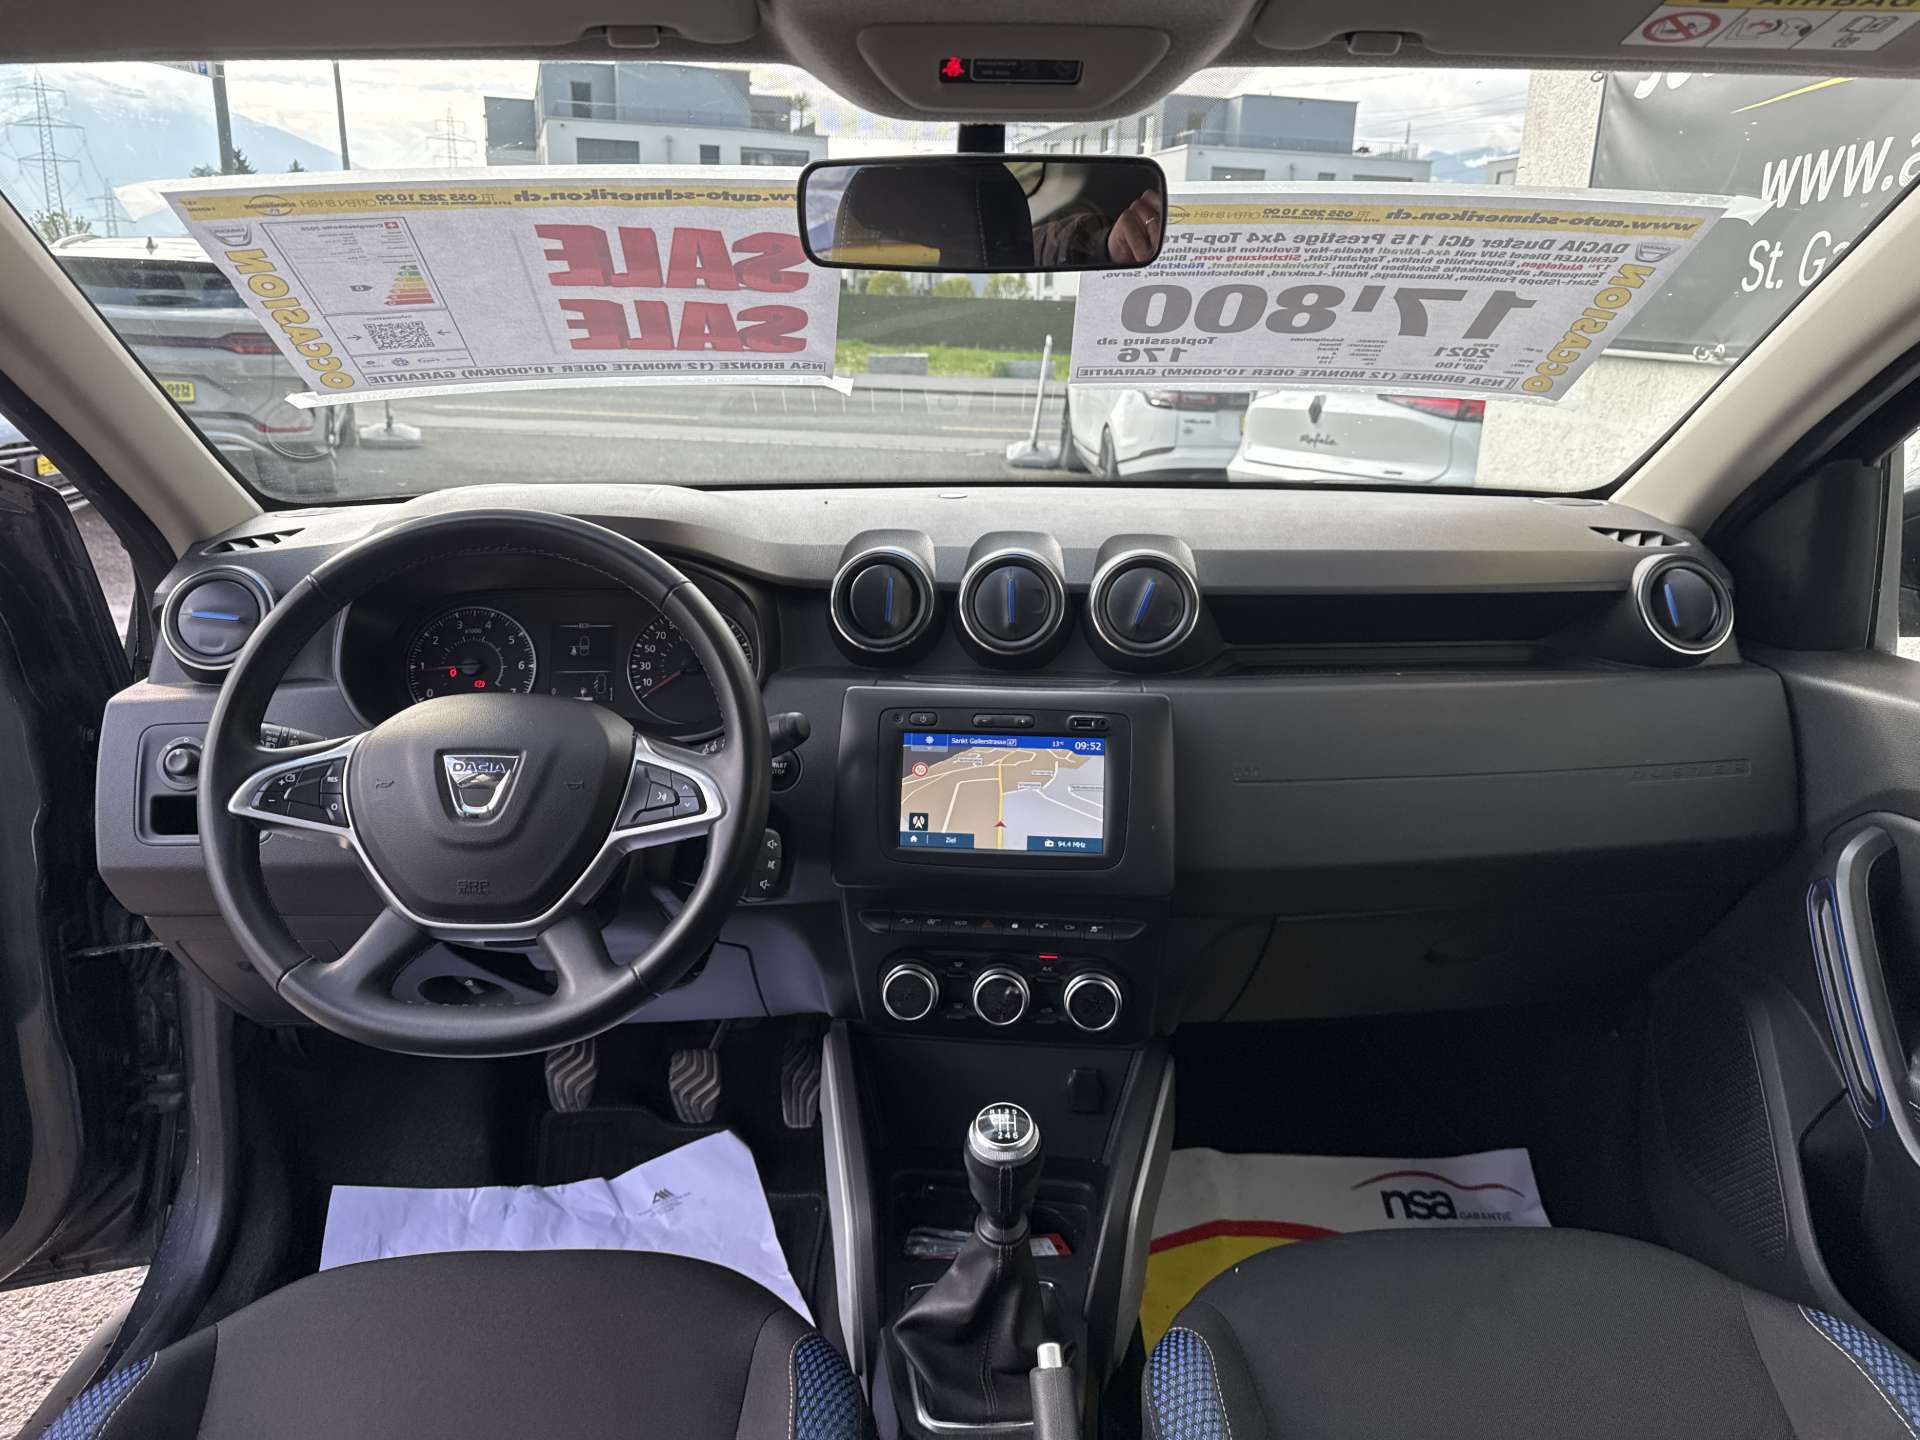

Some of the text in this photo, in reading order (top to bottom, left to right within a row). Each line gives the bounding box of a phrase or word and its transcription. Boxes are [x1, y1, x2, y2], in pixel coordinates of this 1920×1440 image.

[1741, 230, 1851, 292] St. G
[456, 621, 463, 629] 3
[485, 621, 492, 629] 4
[509, 635, 515, 644] 5
[655, 631, 666, 640] 70
[433, 636, 439, 645] 2
[644, 644, 656, 653] 50
[518, 661, 525, 670] 6
[639, 661, 651, 670] 30
[642, 678, 652, 687] 10
[426, 688, 433, 697] 0
[1074, 741, 1102, 751] 09:52
[452, 761, 506, 774] DACIA
[945, 835, 957, 843] Ziel
[1057, 840, 1086, 848] 94.4 MHz
[997, 1131, 1018, 1139] 2 4 6
[1380, 1190, 1458, 1220] nsa
